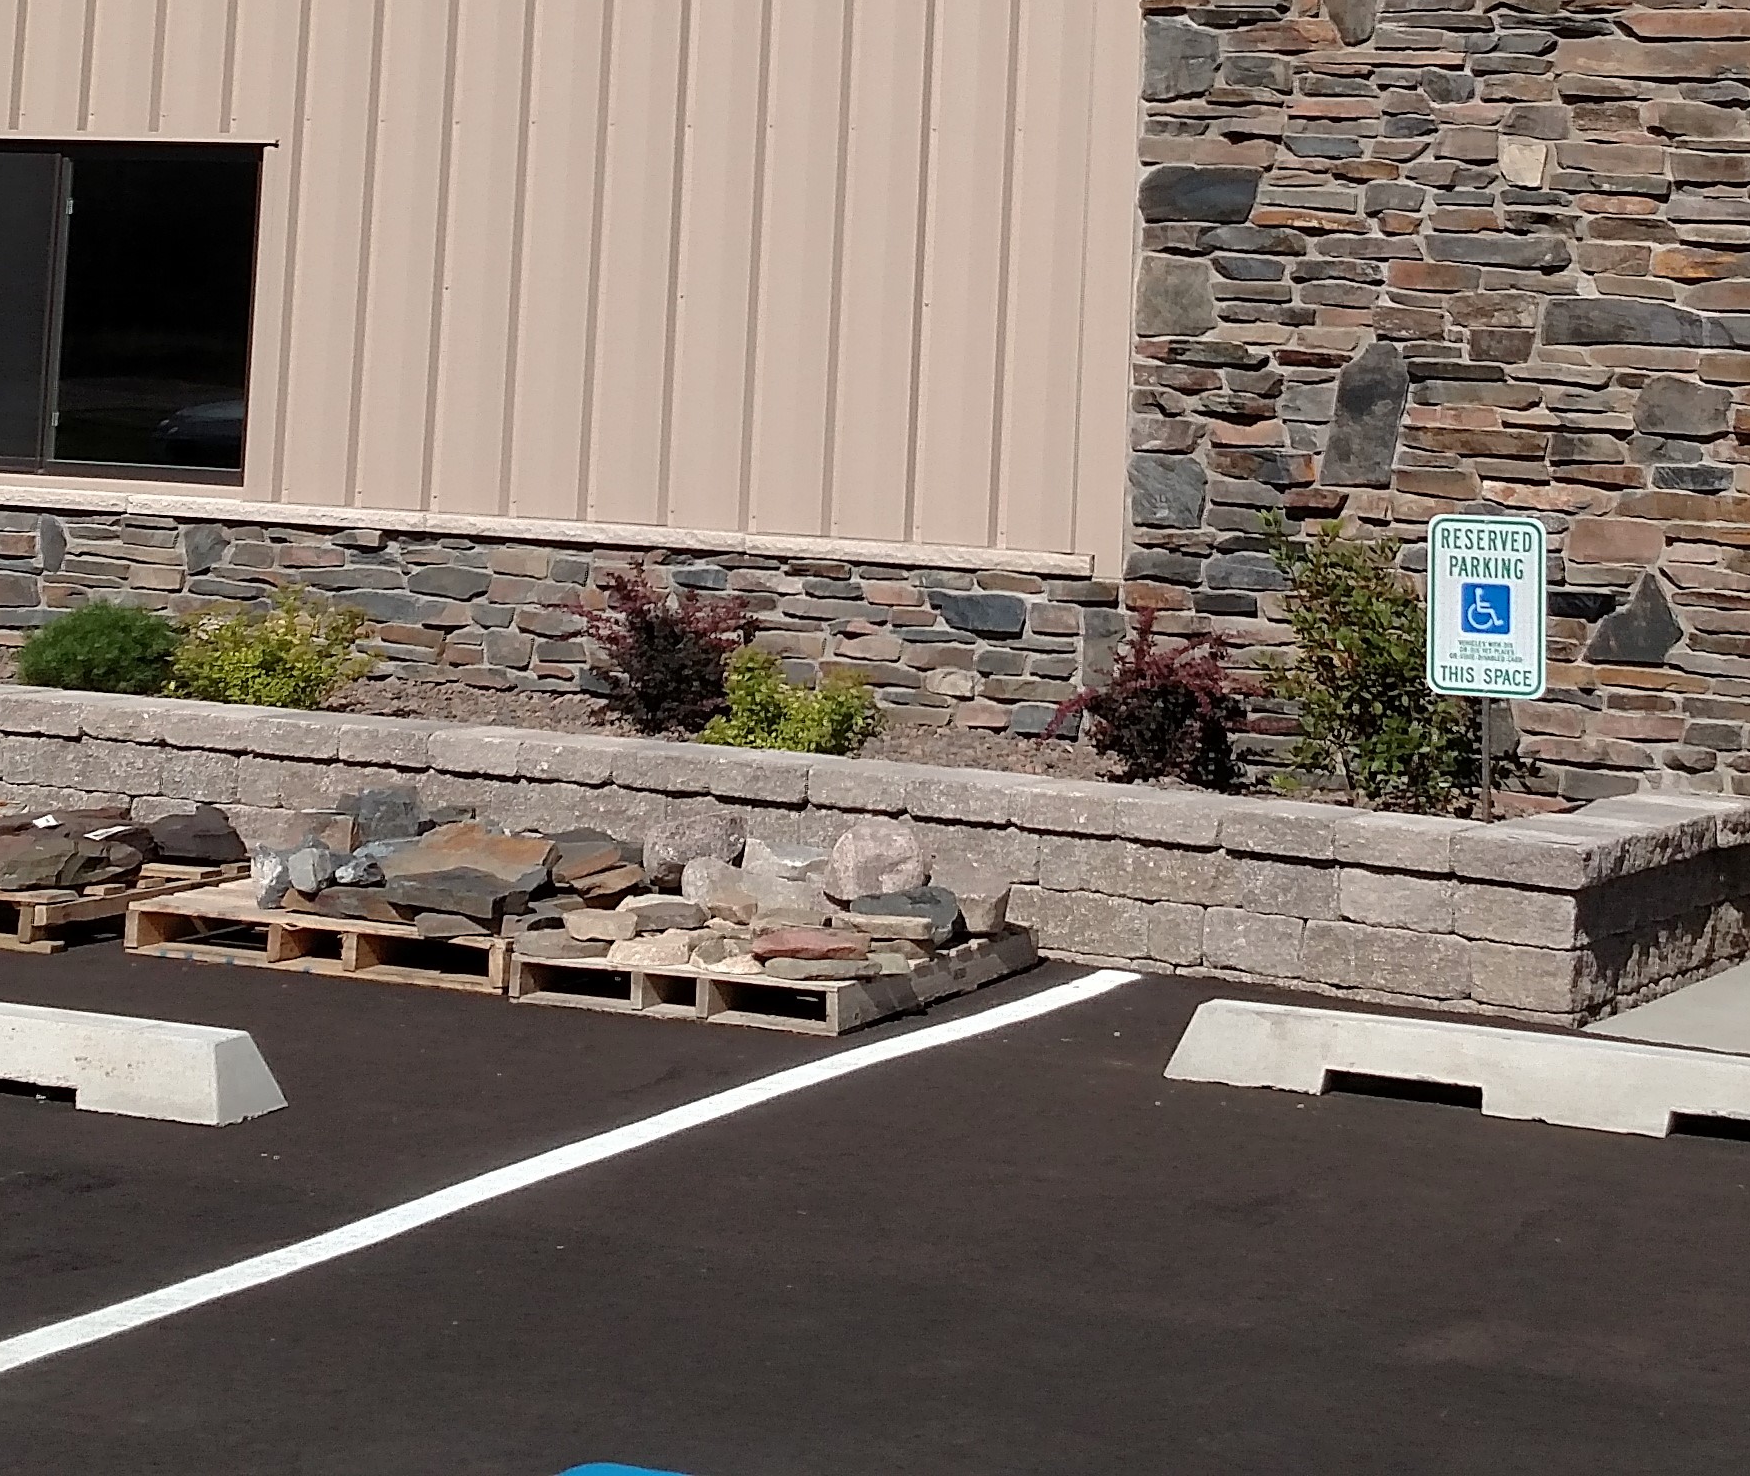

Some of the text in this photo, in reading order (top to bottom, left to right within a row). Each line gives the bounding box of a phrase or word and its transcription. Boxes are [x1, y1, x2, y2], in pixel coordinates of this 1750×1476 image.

[1440, 527, 1533, 553] RESERVED
[1449, 555, 1524, 580] PARKING
[1440, 664, 1532, 688] THIS SPACE
